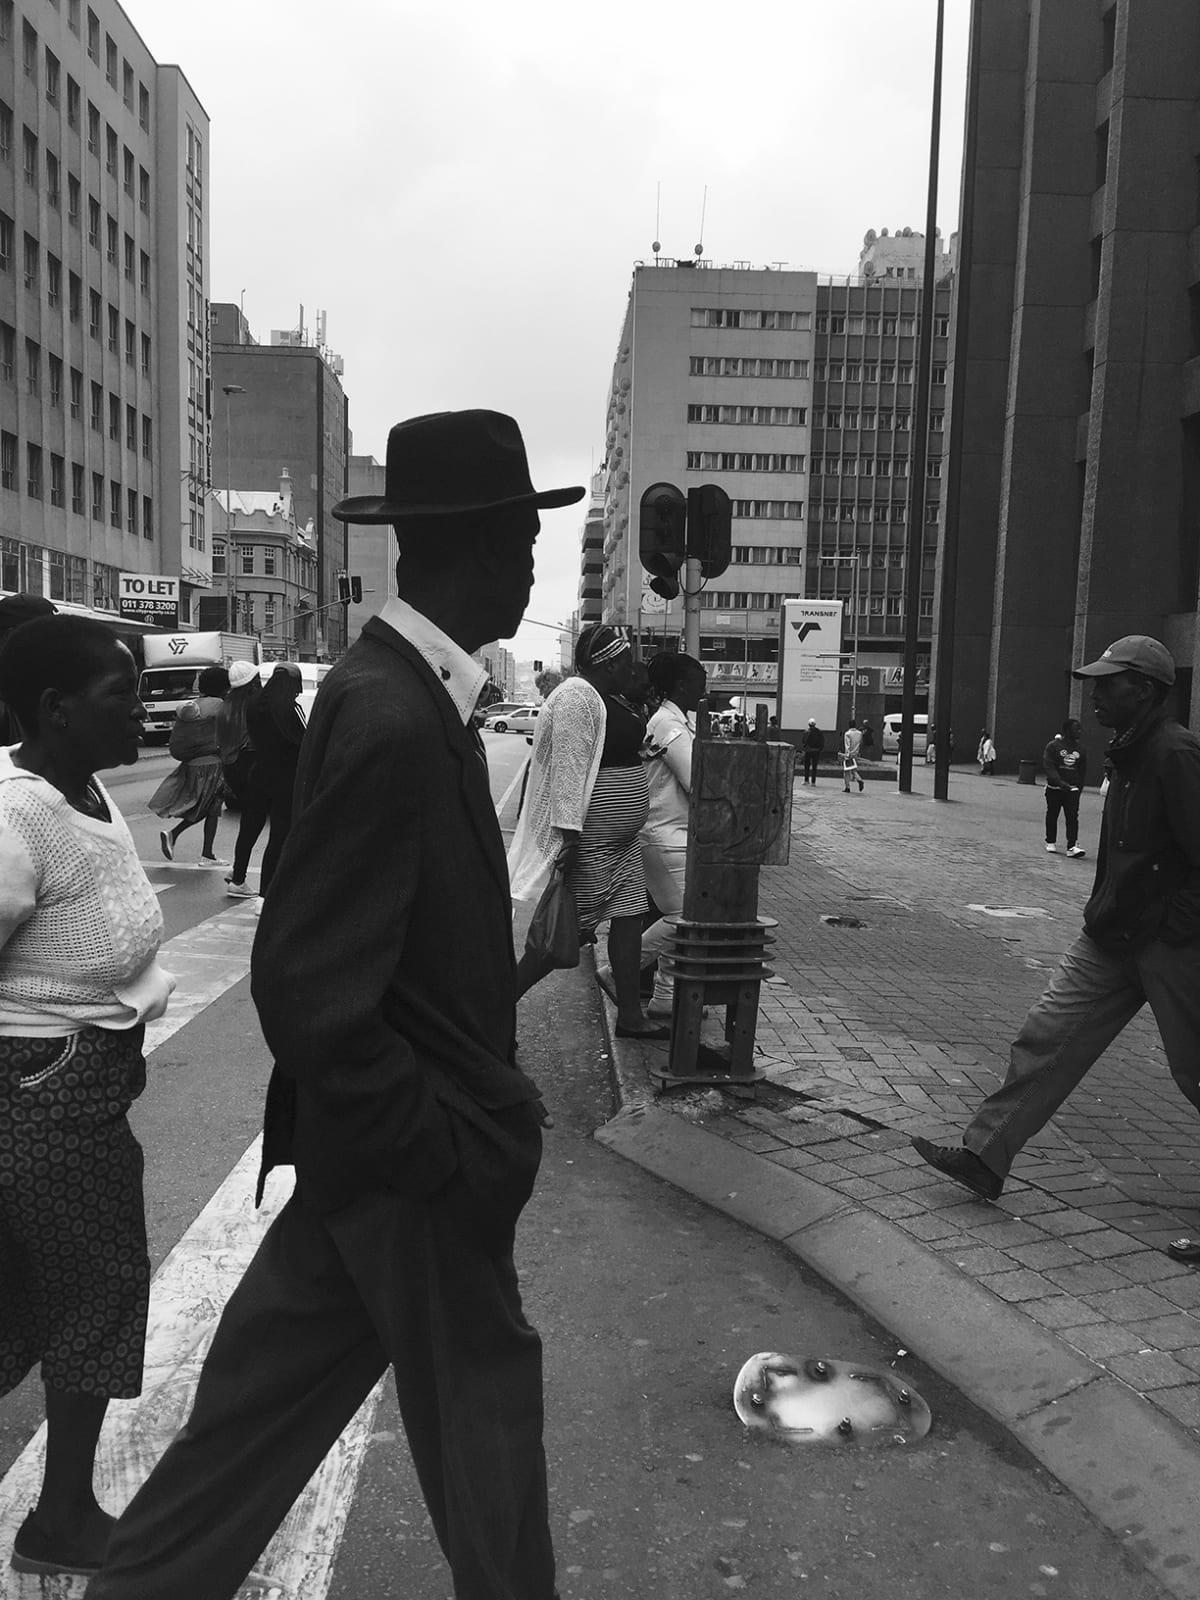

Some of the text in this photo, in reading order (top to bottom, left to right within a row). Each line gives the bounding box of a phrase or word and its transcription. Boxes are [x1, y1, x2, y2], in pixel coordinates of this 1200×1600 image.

[123, 578, 175, 595] TO LET
[122, 600, 176, 610] 011 378 3200
[841, 674, 870, 687] FNB
